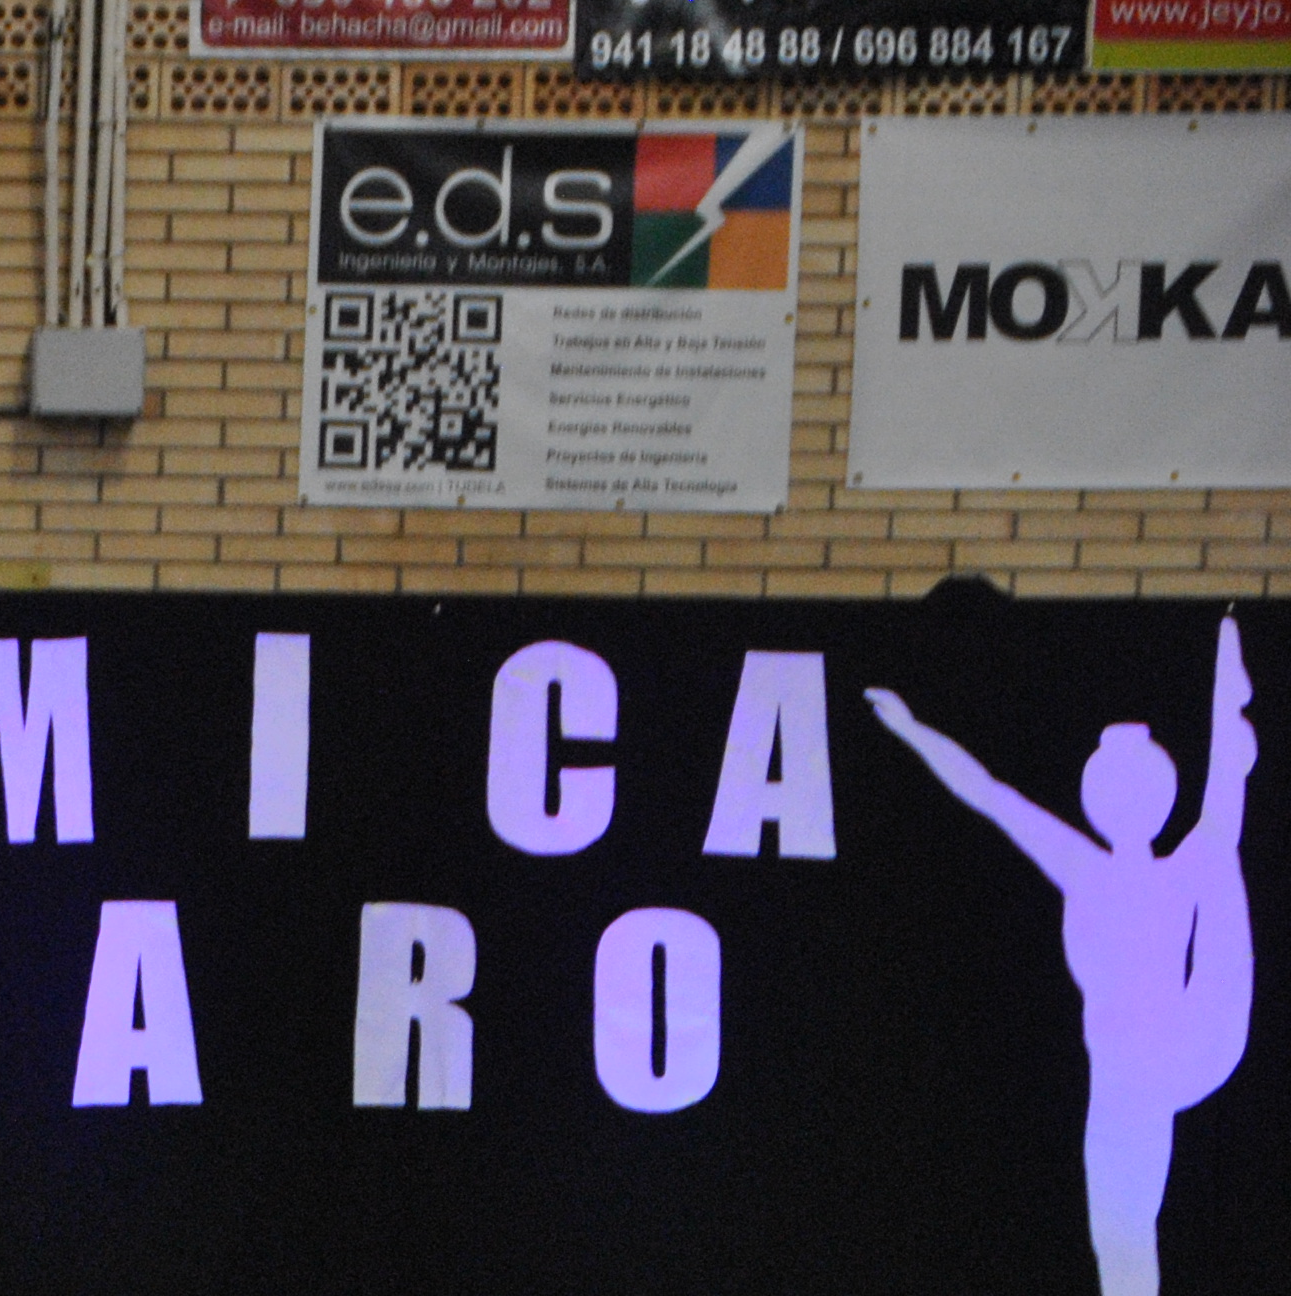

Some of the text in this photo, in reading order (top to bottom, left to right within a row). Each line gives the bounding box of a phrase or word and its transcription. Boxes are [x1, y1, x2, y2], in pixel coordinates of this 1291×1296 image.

[207, 12, 564, 42] e-mail: behacha@gmail.com
[590, 28, 653, 69] 941
[670, 27, 711, 68] 18
[721, 26, 766, 68] 48
[777, 26, 820, 66] 88
[854, 25, 918, 66] 696
[929, 25, 994, 66] 884
[1007, 24, 1072, 65] 167
[339, 144, 615, 250] e.d.s
